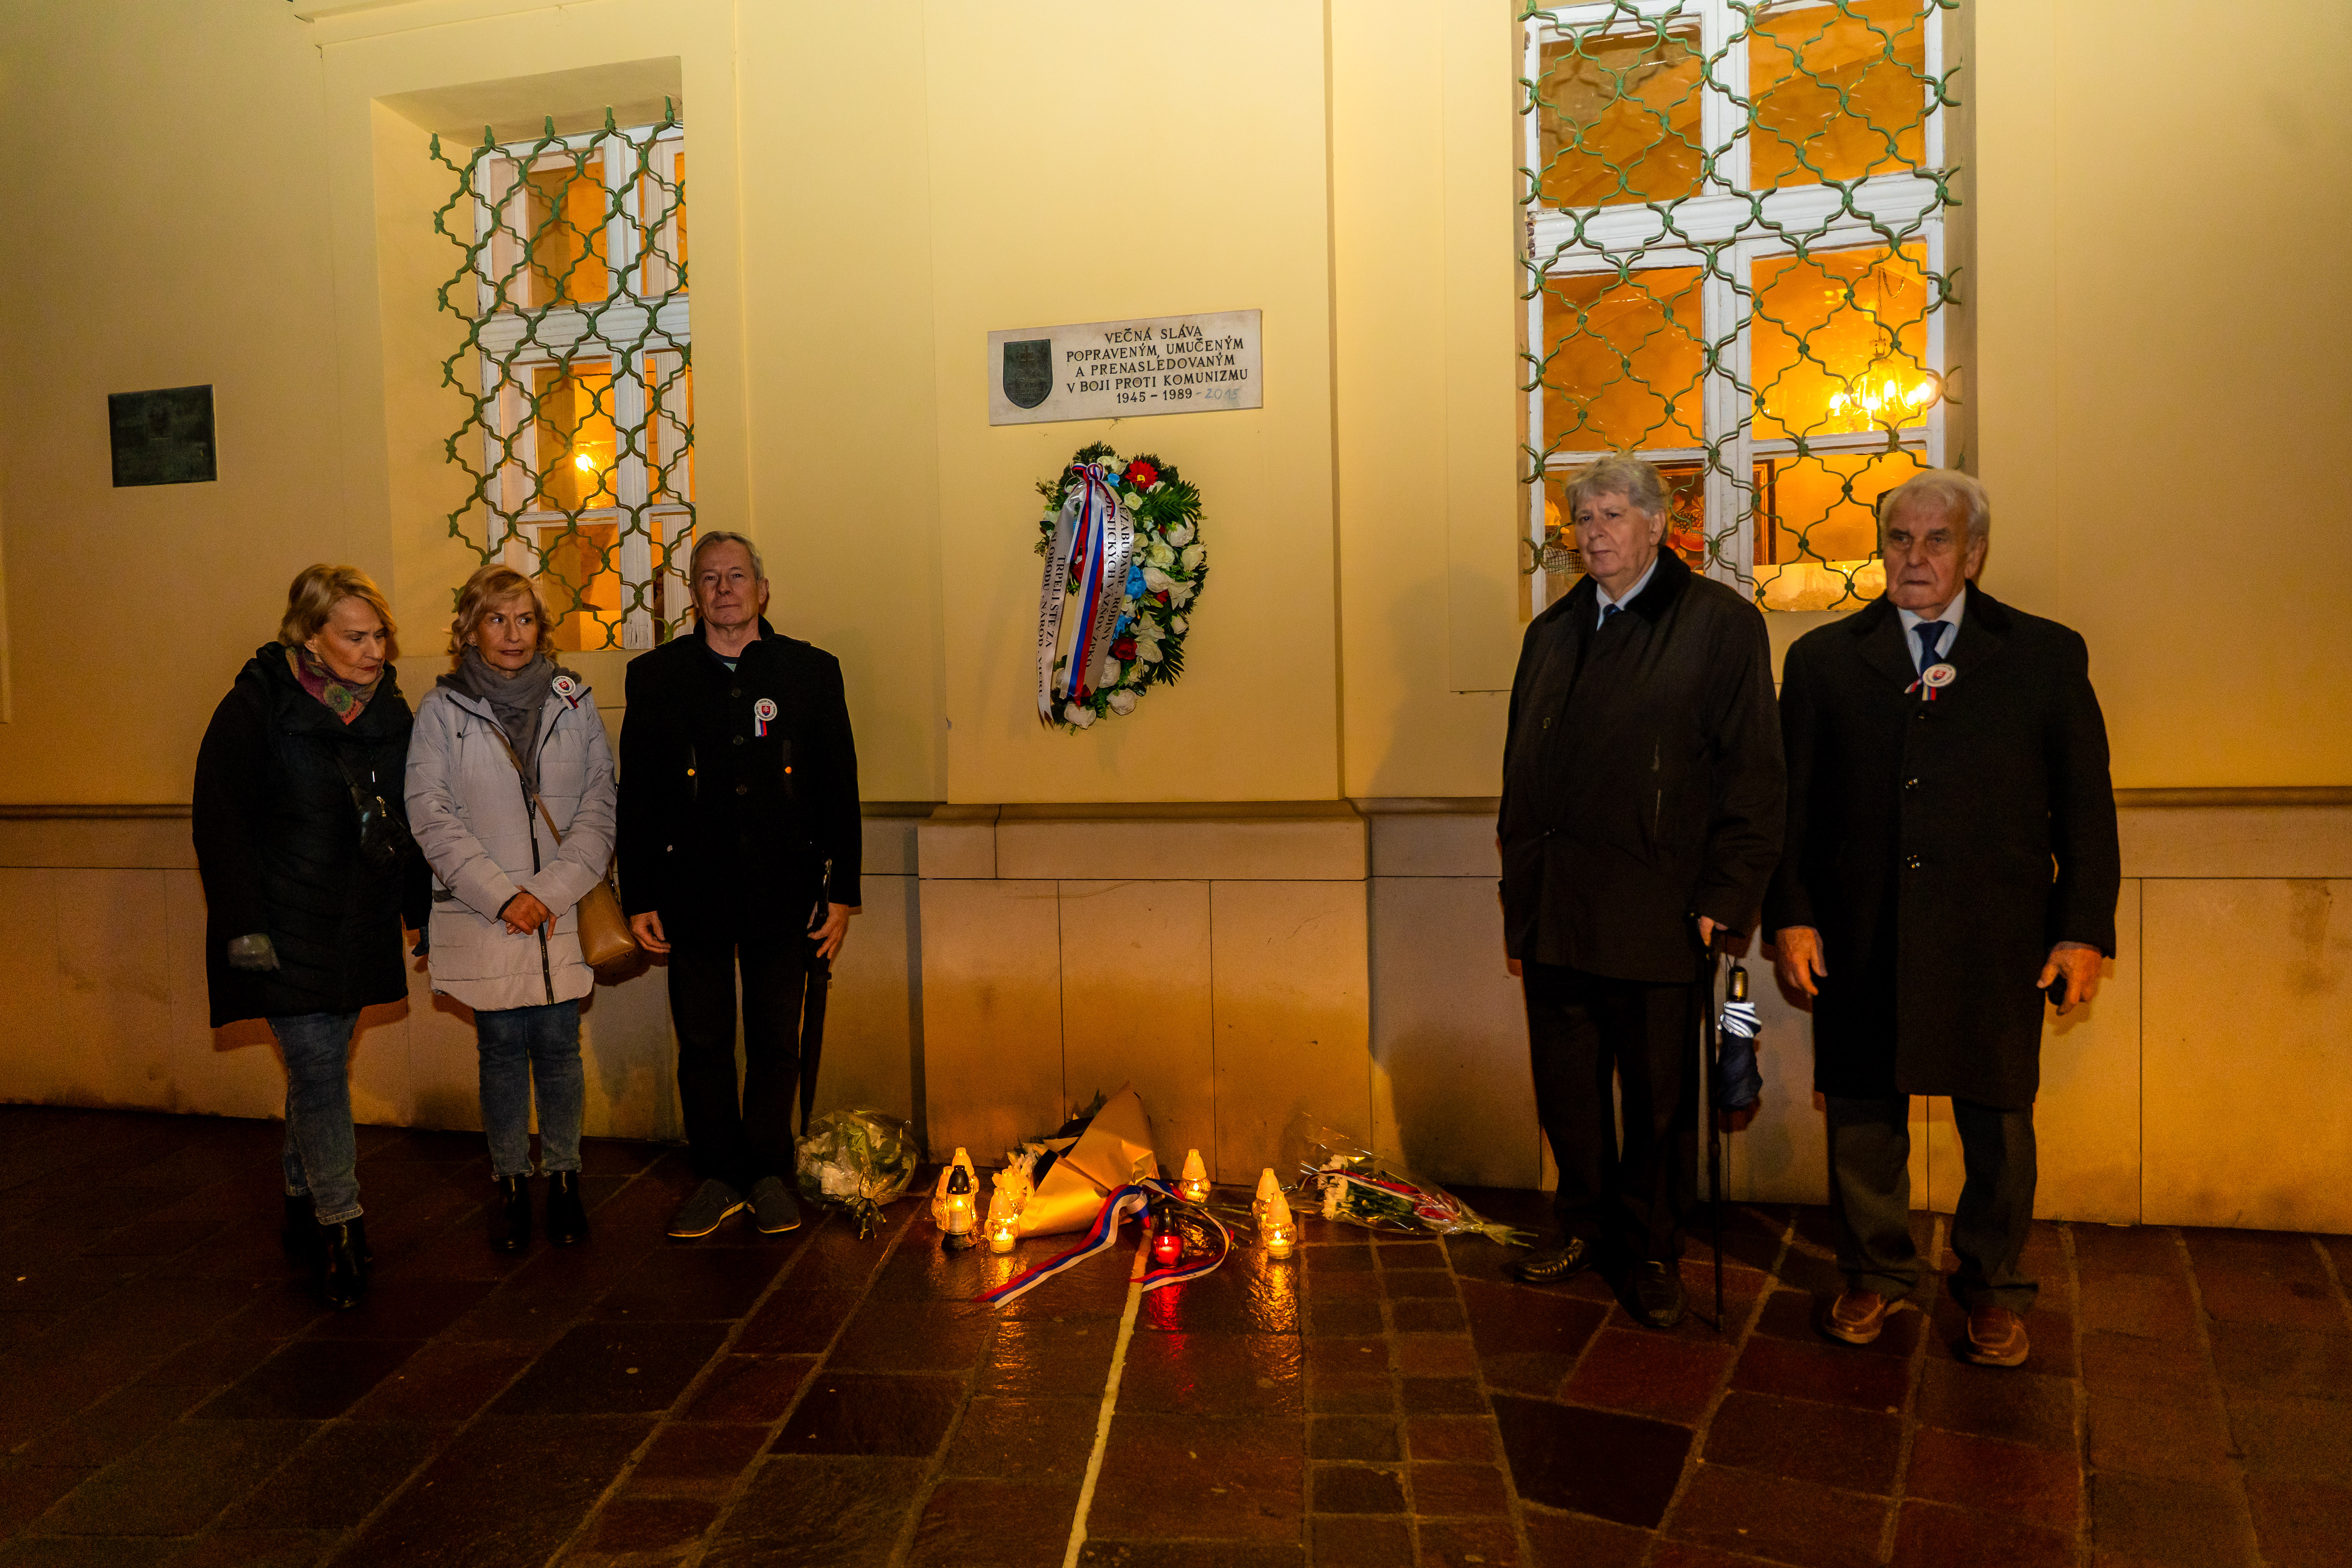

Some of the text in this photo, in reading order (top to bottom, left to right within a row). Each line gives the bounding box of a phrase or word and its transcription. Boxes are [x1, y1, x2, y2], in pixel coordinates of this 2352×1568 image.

[1104, 324, 1203, 344] VEČNÁ SLÁVA
[1166, 335, 1244, 355] UMUČENÝM
[1066, 369, 1248, 394] V BOJI PROTI KOMUNIZMU
[1075, 366, 1085, 377] A
[1116, 392, 1146, 404] 1945
[1163, 388, 1192, 401] 1989
[1105, 496, 1119, 579] OLTICKÝCH
[1043, 532, 1057, 590] SLOBODU
[1045, 555, 1066, 648] TRPELI STE ZA
[1096, 583, 1114, 632] VÄZŇOV
[1102, 597, 1121, 641] RODINY
[1038, 601, 1047, 647] NÁROD
